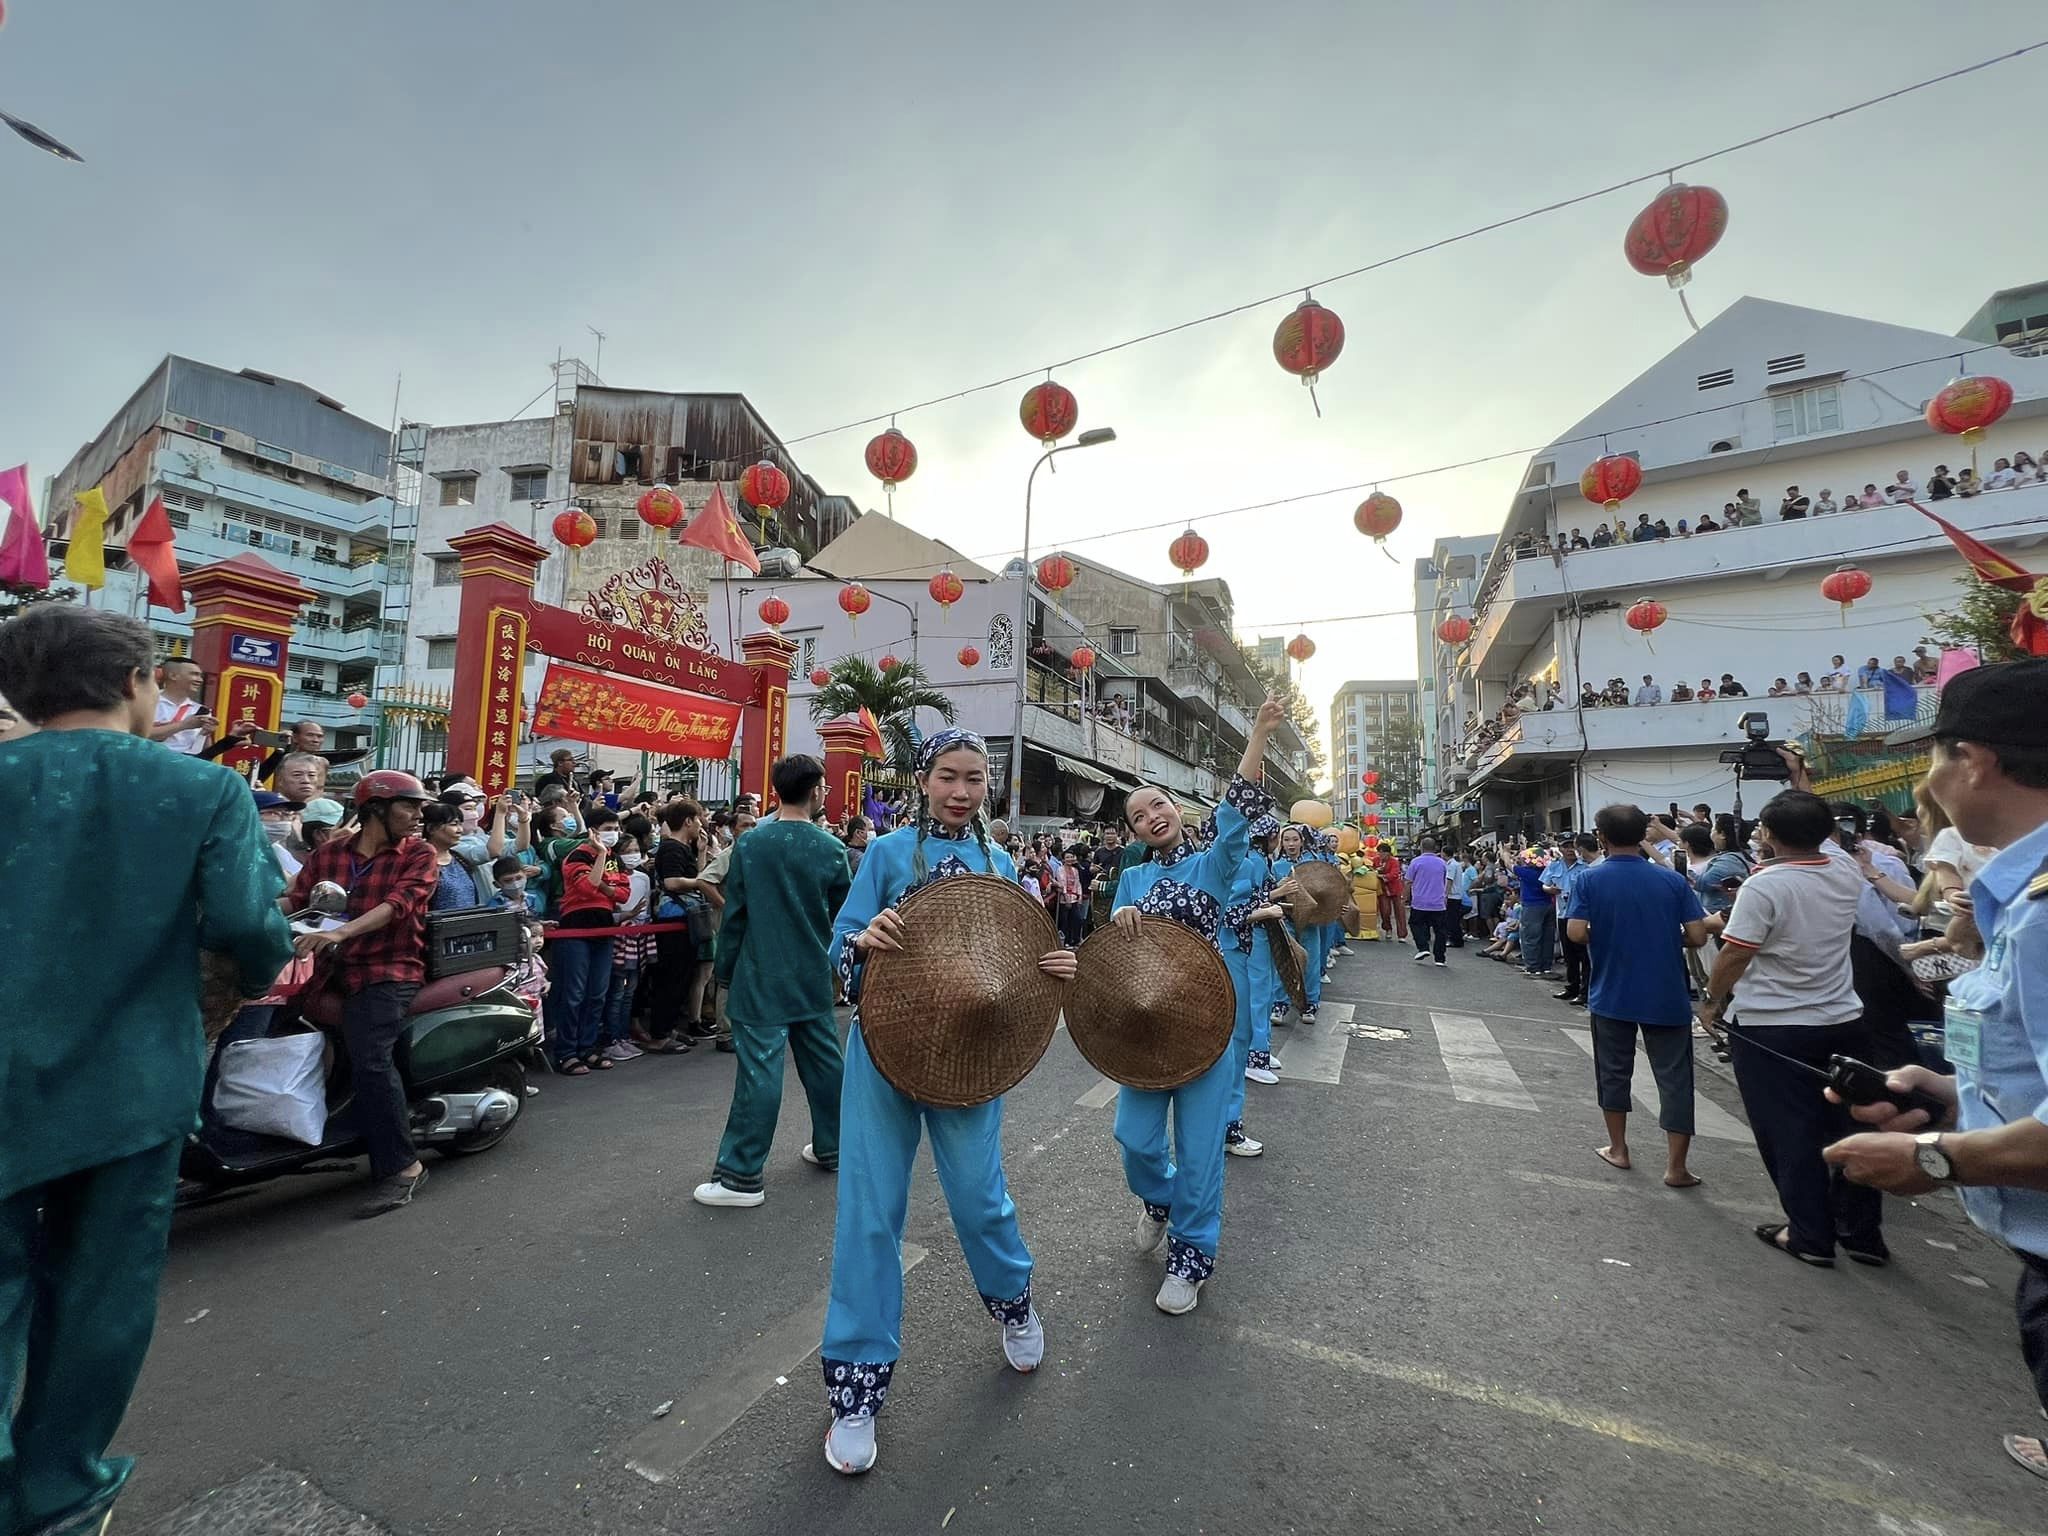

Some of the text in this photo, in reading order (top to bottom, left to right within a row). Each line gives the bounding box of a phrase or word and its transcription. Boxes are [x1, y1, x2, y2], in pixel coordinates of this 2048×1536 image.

[238, 638, 273, 657] 5
[587, 633, 612, 652] HỘI
[665, 653, 680, 670] ÔN
[618, 702, 656, 731] Chúc
[647, 706, 688, 742] Mừng
[1933, 959, 1952, 975] NY
